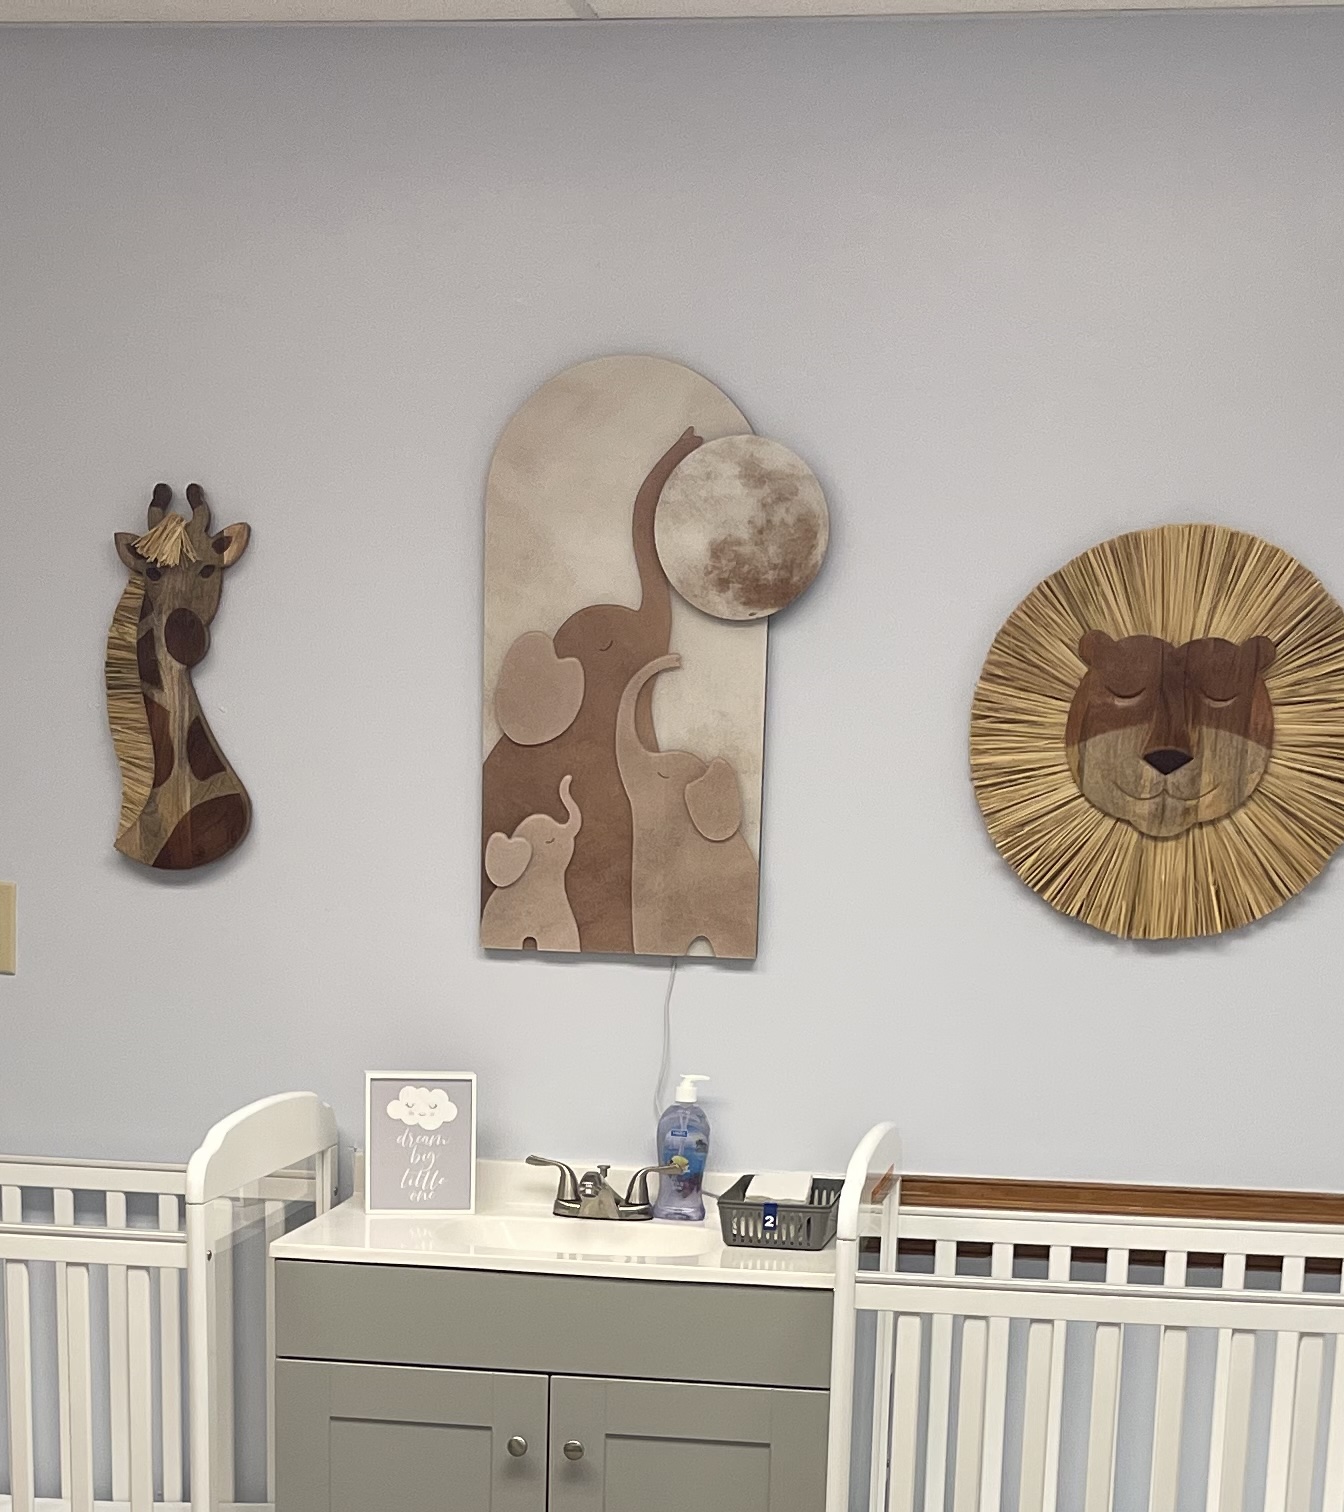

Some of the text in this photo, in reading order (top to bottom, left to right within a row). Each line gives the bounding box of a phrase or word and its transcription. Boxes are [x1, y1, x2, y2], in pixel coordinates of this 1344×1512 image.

[396, 1127, 449, 1148] dream
[409, 1144, 436, 1172] big
[400, 1168, 448, 1191] little
[764, 1215, 775, 1228] 2
